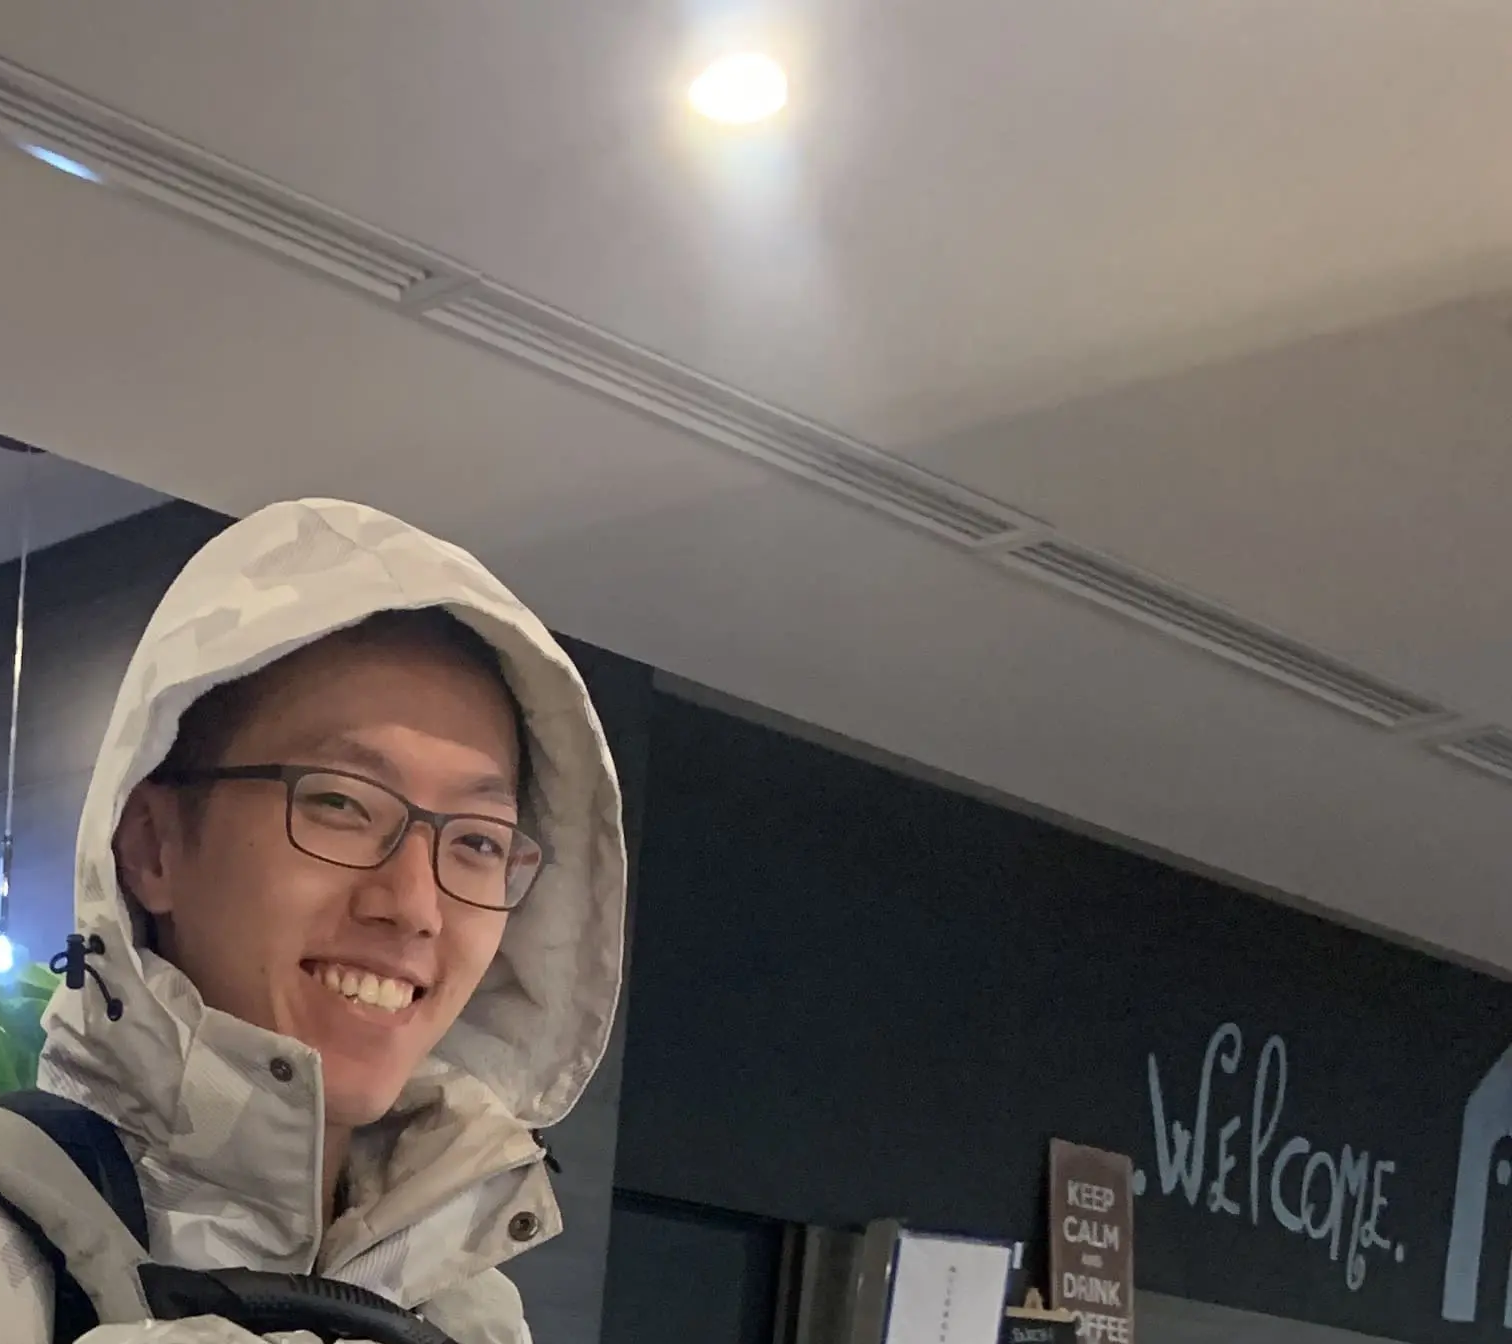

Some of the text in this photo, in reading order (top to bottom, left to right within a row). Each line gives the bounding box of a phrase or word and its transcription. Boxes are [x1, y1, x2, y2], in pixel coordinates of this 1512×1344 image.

[1067, 1180, 1115, 1213] KEEP
[1063, 1215, 1119, 1252] CALM
[1063, 1272, 1121, 1307] DRINK
[1071, 1310, 1129, 1344] OFFEE
